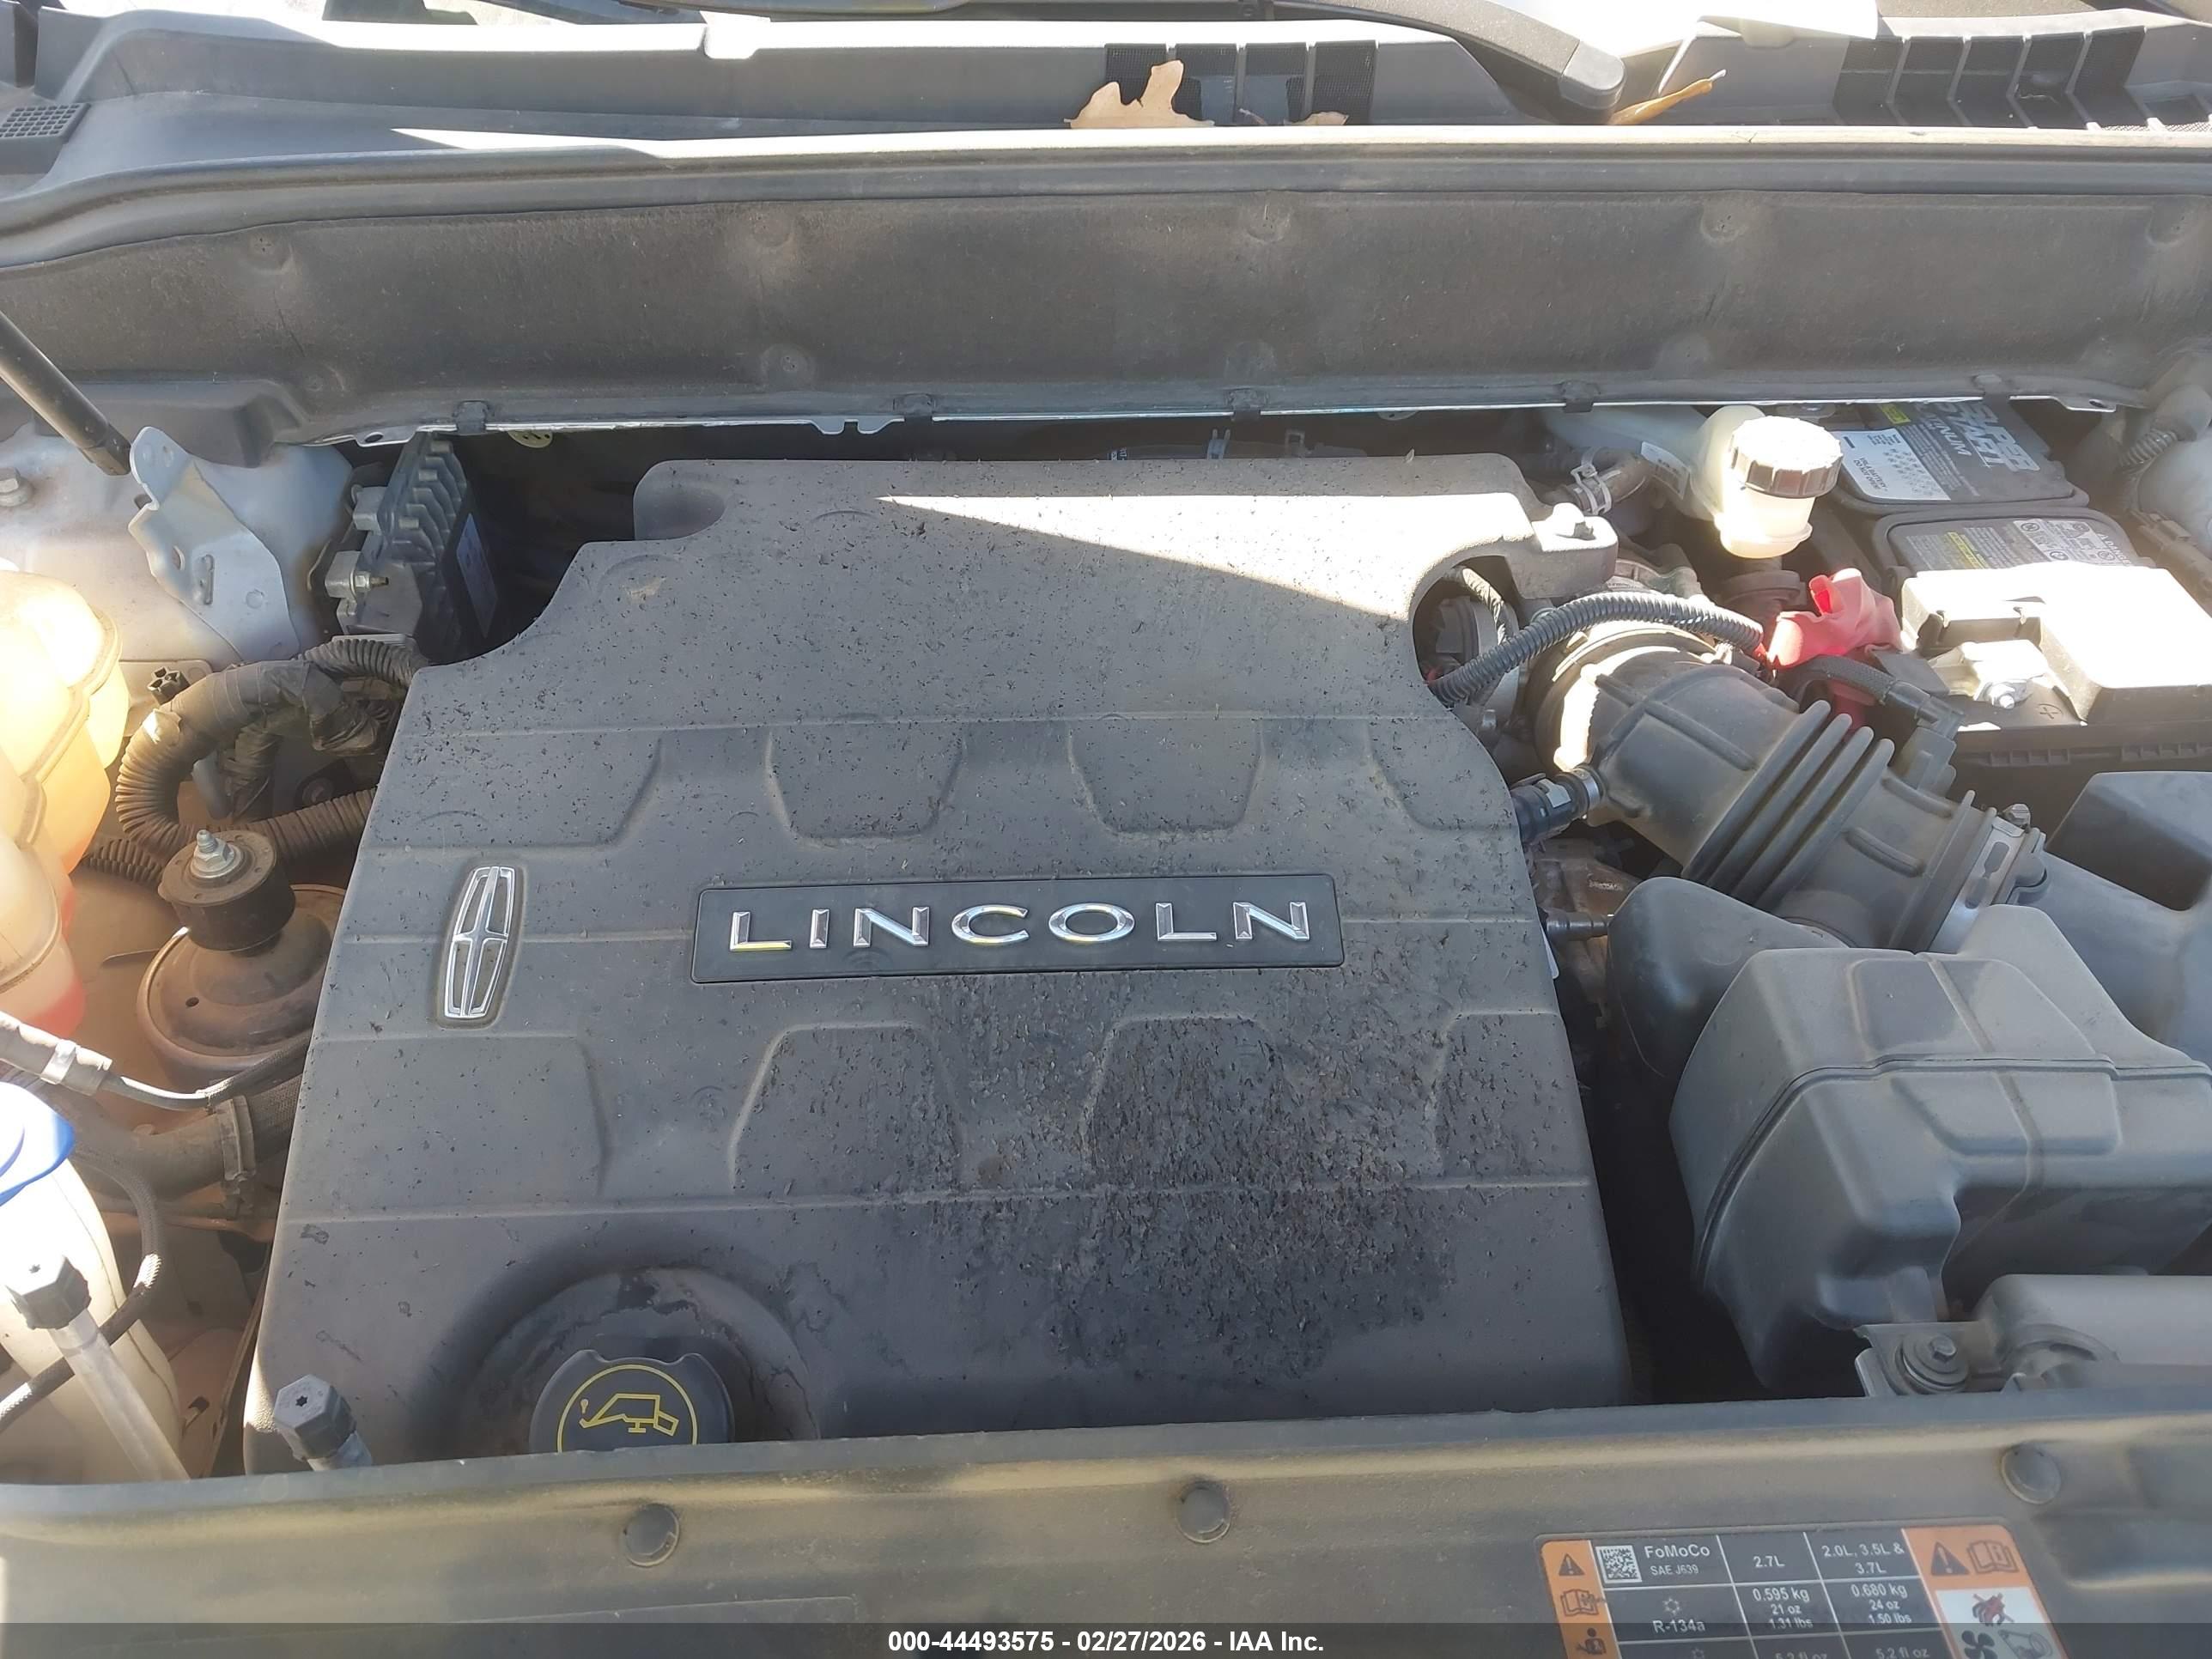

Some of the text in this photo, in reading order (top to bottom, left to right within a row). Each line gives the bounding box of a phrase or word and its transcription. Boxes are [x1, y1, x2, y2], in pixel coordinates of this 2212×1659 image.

[729, 902, 1311, 951] LINCOLN
[1644, 1544, 1711, 1559] FoMoCo
[1821, 1542, 1905, 1558] 2.0L, 3.5L &
[1753, 1556, 1785, 1568] 2.7L
[1855, 1562, 1887, 1575] 3.7L
[1650, 1564, 1699, 1577] SAE J639
[1753, 1587, 1810, 1603] 0.595 kg
[1850, 1583, 1909, 1599] 0.680 kg
[1771, 1604, 1802, 1615] 21 oz
[1869, 1600, 1900, 1611] 24 oz
[1652, 1619, 1706, 1633] R-134a
[1769, 1617, 1814, 1630] 1.31 lbs
[1869, 1613, 1912, 1626] 1.50 lbs
[1875, 1646, 1930, 1659] 5.2 fl oz
